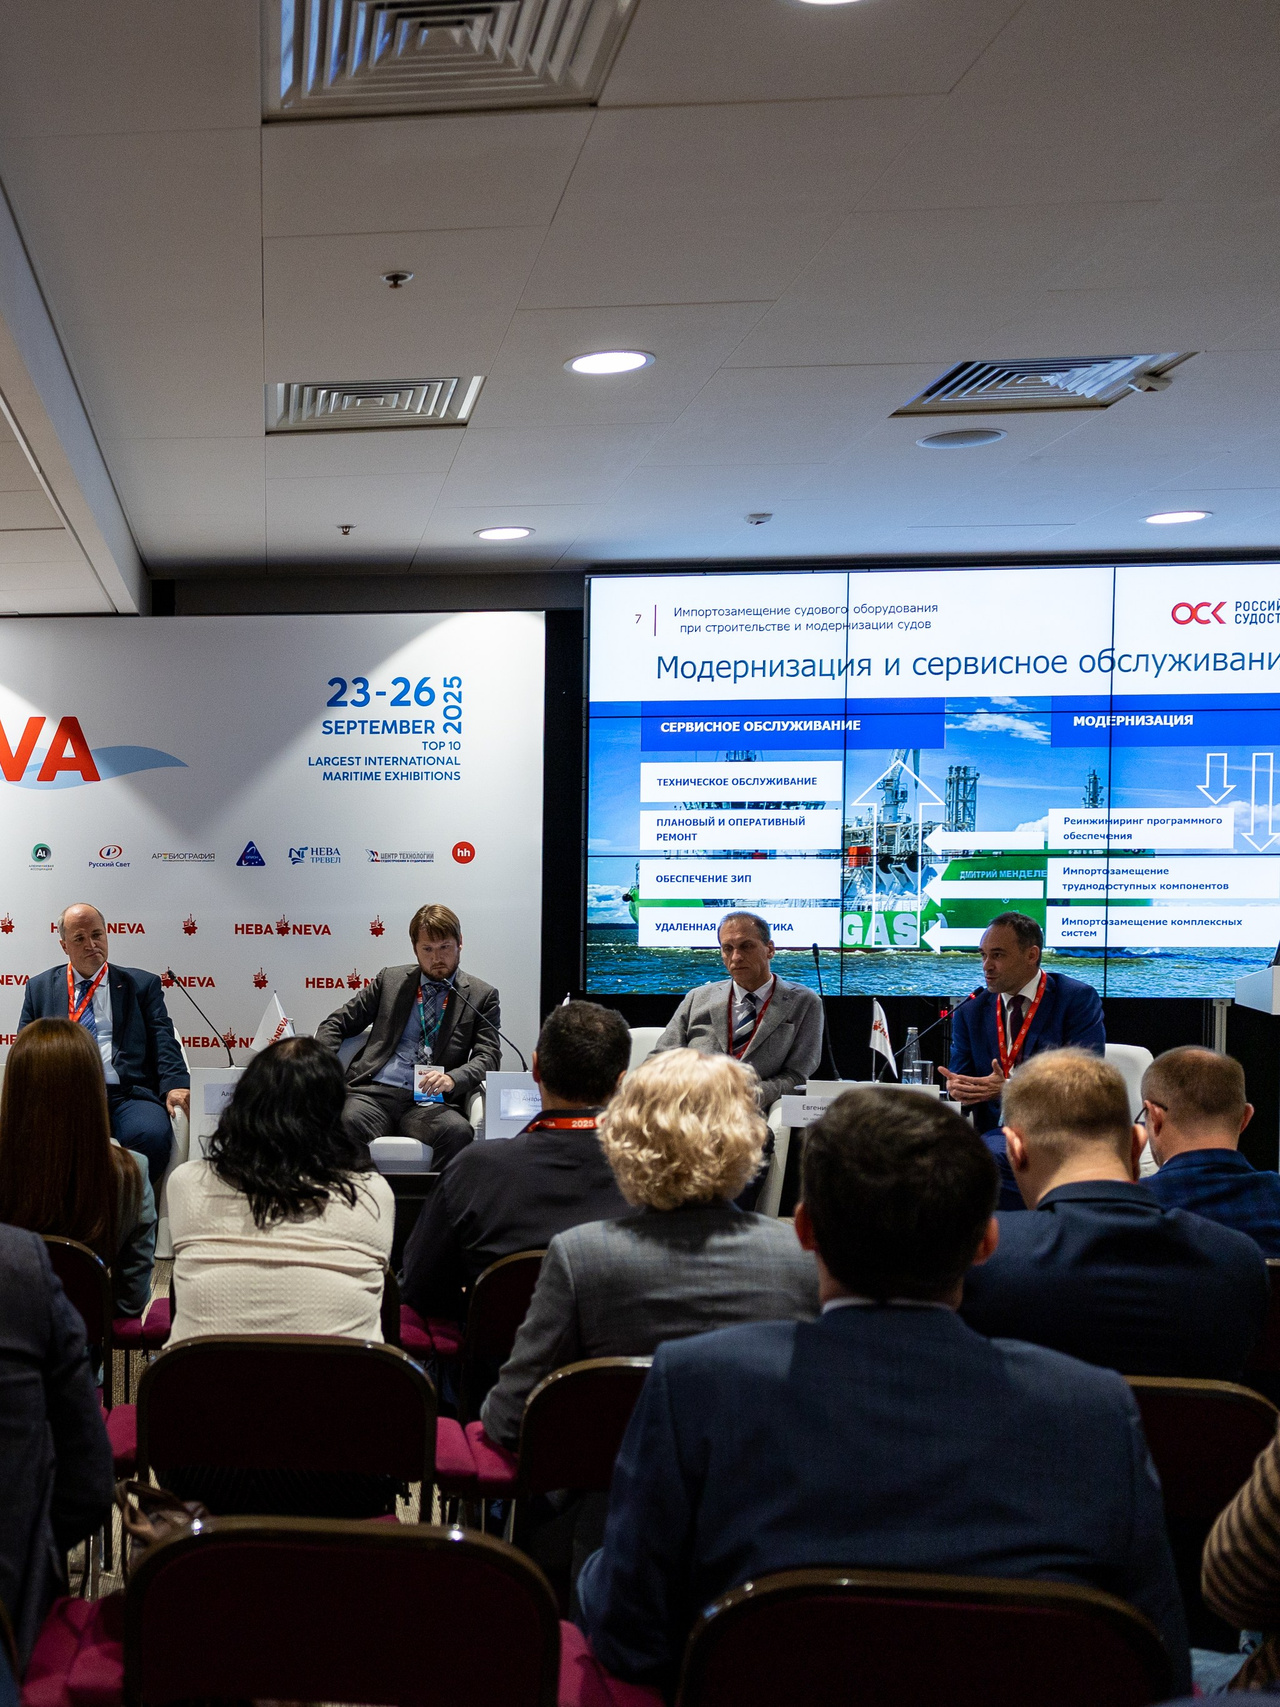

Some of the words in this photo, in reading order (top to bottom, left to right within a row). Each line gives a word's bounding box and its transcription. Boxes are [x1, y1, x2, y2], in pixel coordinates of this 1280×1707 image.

[673, 606, 791, 620] Импортозамещение
[794, 606, 848, 617] судового
[853, 603, 939, 616] оборудования
[1171, 601, 1227, 625] ОСК
[634, 613, 642, 624] 7
[680, 624, 702, 635] при
[705, 623, 791, 635] строительстве
[794, 622, 802, 631] и
[805, 620, 894, 632] модернизации
[897, 619, 932, 632] судов
[657, 655, 872, 684] Модернизация
[884, 658, 901, 676] и
[912, 653, 1068, 681] сервисное
[1078, 647, 1280, 679] обслуживани
[326, 676, 436, 708] 23-26
[442, 675, 463, 735] 2025
[321, 719, 436, 735] SEPTEMBER
[660, 720, 740, 733] СЕРВИСНОЕ
[743, 719, 862, 732] ОБСЛУЖИВАНИЕ
[1073, 714, 1194, 728] МОДЕРНИЗАЦИЯ
[421, 741, 446, 751] TOP
[448, 741, 462, 751] 10
[308, 756, 362, 766] LARGEST
[364, 756, 462, 766] INTERNATIONAL
[322, 771, 382, 781] MARITIME
[384, 771, 462, 781] EXHIBITIONS
[656, 777, 729, 787] ТЕХНИЧЕСКОЕ
[731, 776, 818, 786] ОБСЛУЖИВАНИЕ
[656, 816, 716, 827] ПЛАНОВЫЙ
[718, 817, 726, 827] И
[728, 815, 806, 827] ОПЕРАТИВНЫЙ
[1063, 816, 1144, 827] Реинжиниринг
[1146, 816, 1223, 828] программного
[656, 832, 698, 842] РЕМОНТ
[1063, 831, 1133, 841] обеспечения
[310, 847, 341, 856] НЕВА
[457, 848, 471, 857] hh
[88, 861, 114, 869] Русский
[960, 868, 998, 880] ДМИТРИЙ
[999, 869, 1048, 879] МЕНДЕЛЕ
[1062, 866, 1170, 877] Импортозамещение
[655, 874, 729, 884] ОБЕСПЕЧЕНИЕ
[730, 874, 752, 884] ЗИП
[1062, 882, 1157, 893] труднодоступных
[1159, 882, 1230, 891] компонентов
[107, 922, 146, 934] NEVA
[655, 922, 717, 933] УДАЛЕННАЯ
[1061, 917, 1168, 928] Импортозамещение
[1170, 917, 1243, 927] комплексных
[234, 923, 274, 935] НЕВА
[292, 923, 332, 936] NEVA
[1061, 929, 1097, 938] систем
[179, 976, 216, 988] NEVA
[305, 977, 345, 989] НЕВА
[183, 1036, 221, 1048] НЕВА
[571, 1119, 595, 1128] 2025
